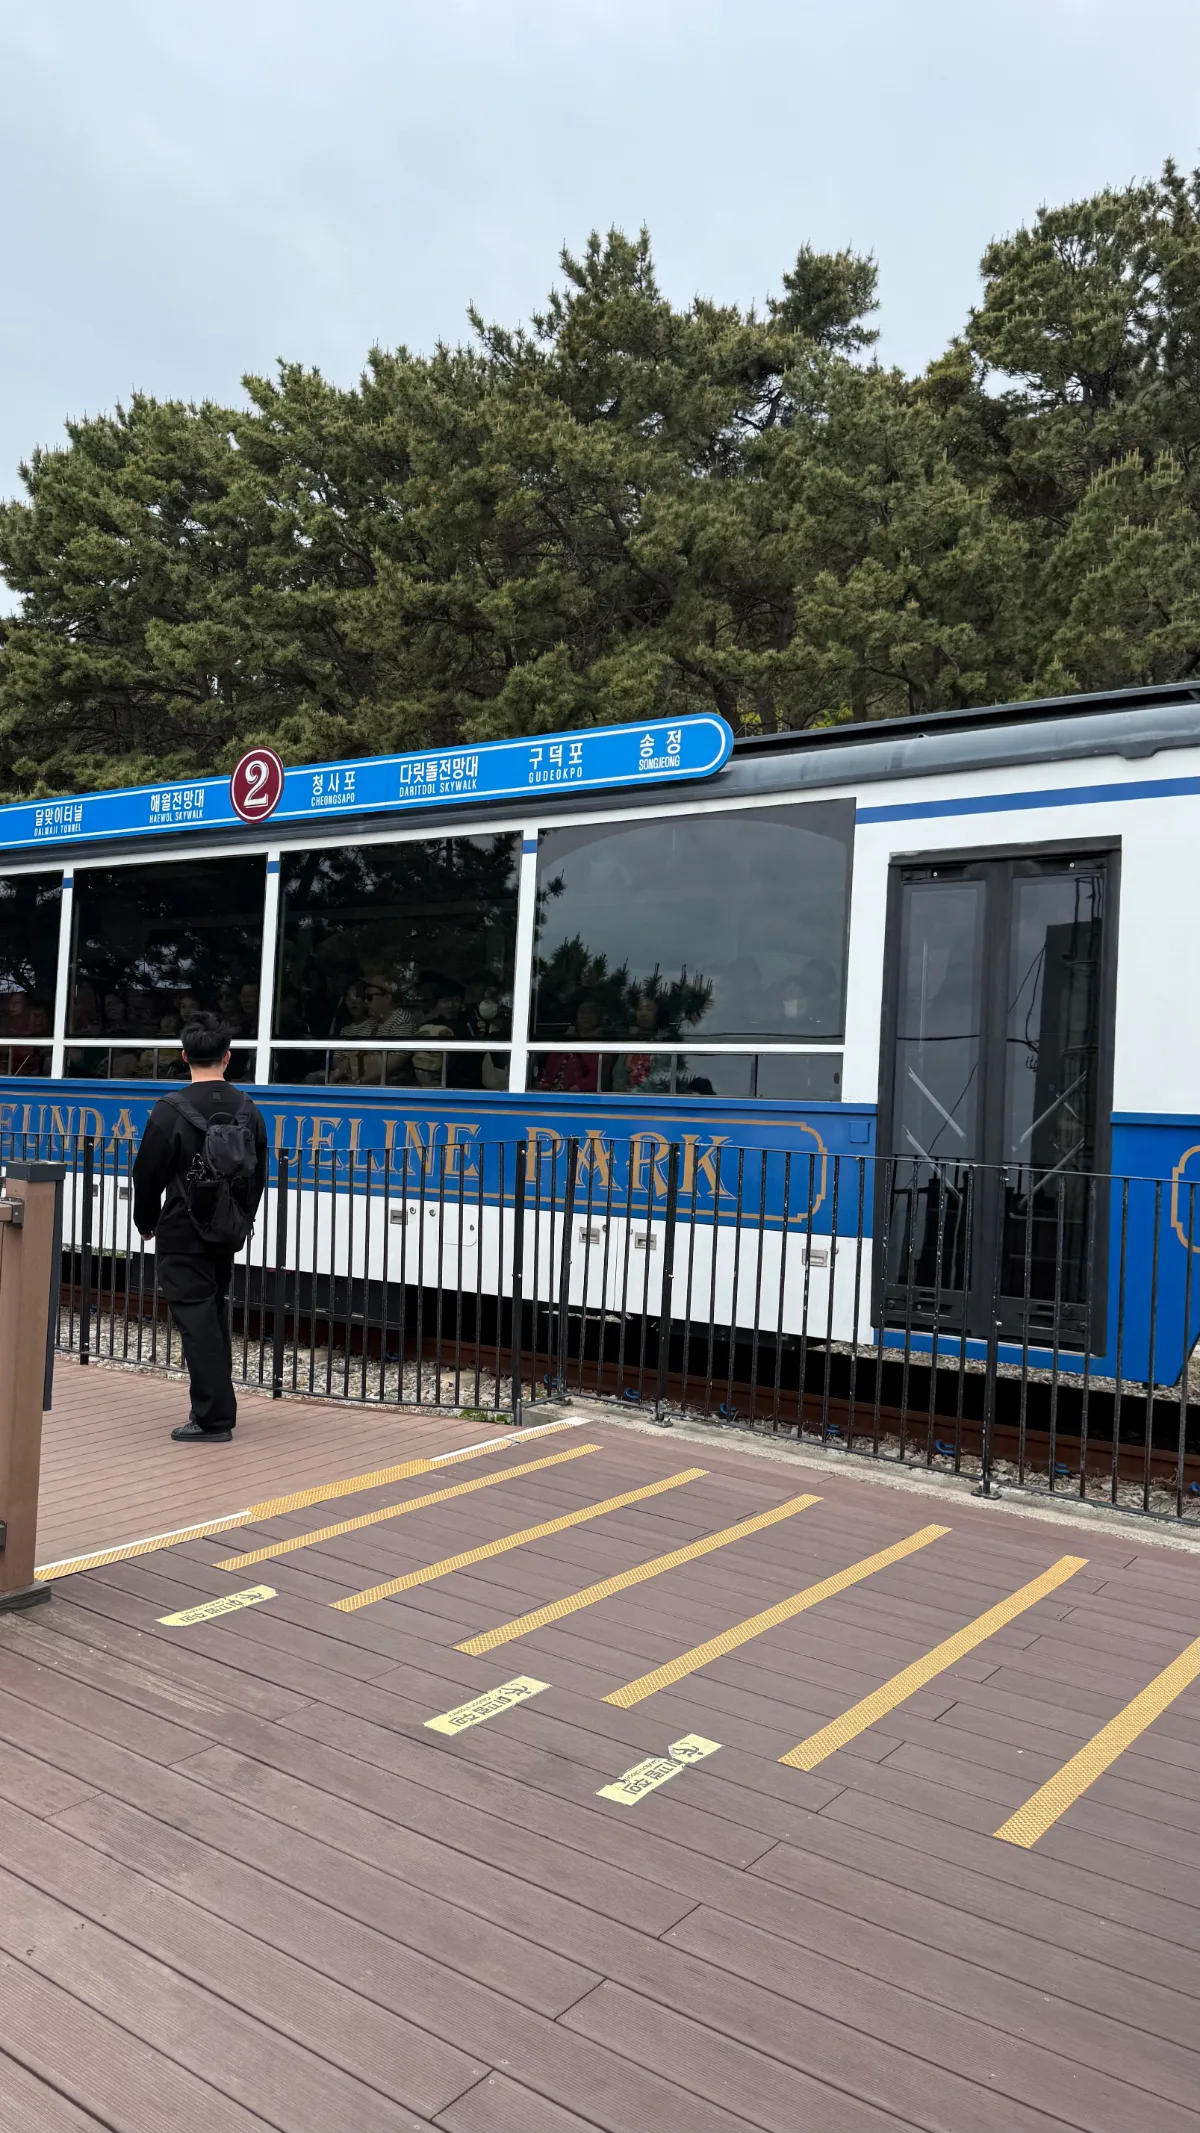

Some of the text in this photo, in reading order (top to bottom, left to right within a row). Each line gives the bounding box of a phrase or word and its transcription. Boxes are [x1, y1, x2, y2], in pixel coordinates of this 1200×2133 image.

[640, 729, 682, 758] 송정
[529, 742, 583, 770] 구덕포
[638, 755, 680, 771] SONGJEONG
[400, 755, 479, 785] 다릿돌전망대
[528, 766, 583, 784] GUDEOKPO
[243, 760, 270, 809] 2
[312, 770, 356, 796] 청사포
[399, 779, 478, 798] DARITDOL SKYWALK
[150, 789, 205, 813] 해월전망대
[311, 792, 355, 807] CHEONGSAPO
[35, 804, 83, 827] 달맞이터널
[149, 809, 204, 824] HAEWOL SKYWALK
[0, 1103, 737, 1200] EUNDA UELINE PARK
